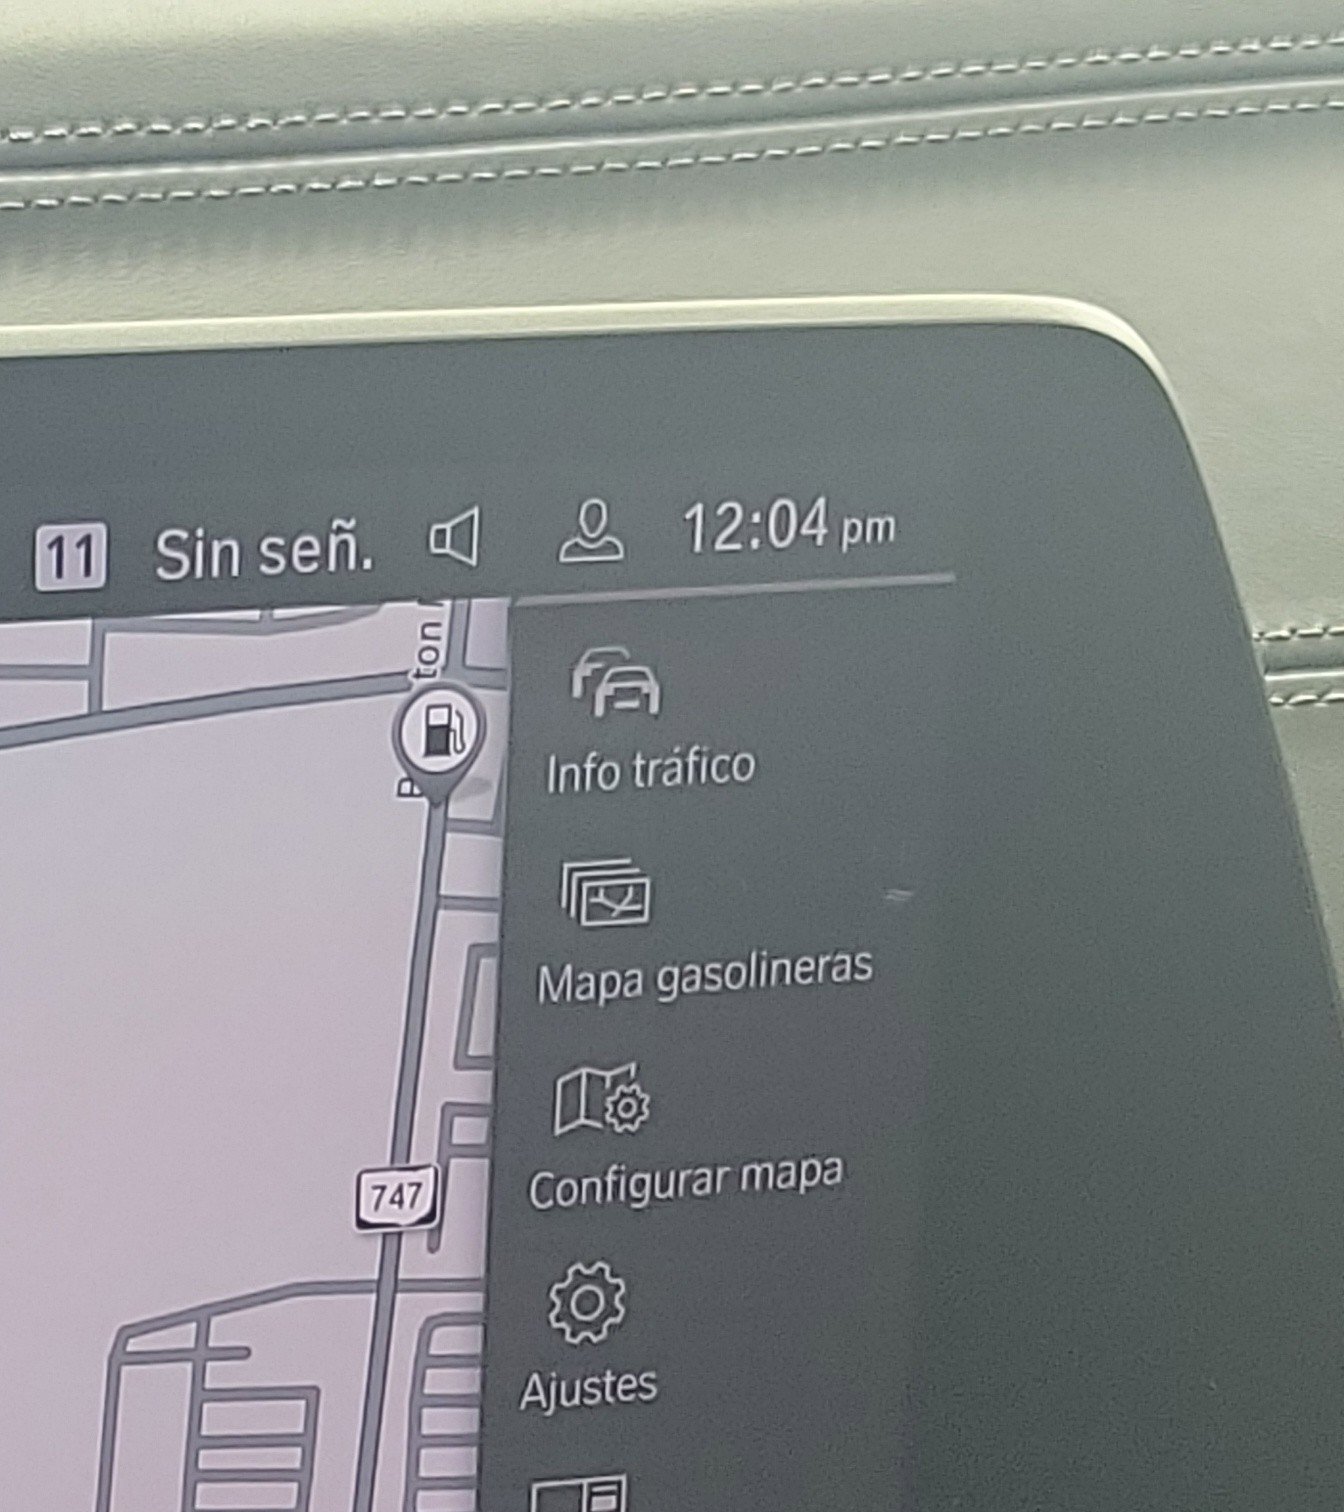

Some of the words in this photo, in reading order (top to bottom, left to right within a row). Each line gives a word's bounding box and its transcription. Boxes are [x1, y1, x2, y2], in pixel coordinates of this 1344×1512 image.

[156, 529, 241, 580] Sin
[258, 517, 374, 576] señ.
[683, 499, 829, 554] 12:04
[841, 508, 897, 550] pm
[47, 536, 94, 578] 11
[546, 750, 622, 795] Info
[634, 744, 756, 791] tráfico
[538, 962, 644, 1007] Mapa
[656, 946, 874, 1001] gasolineras
[370, 1182, 423, 1213] 747
[529, 1162, 730, 1210] Configurar
[740, 1154, 844, 1193] mapa
[519, 1368, 658, 1416] Ajustes
